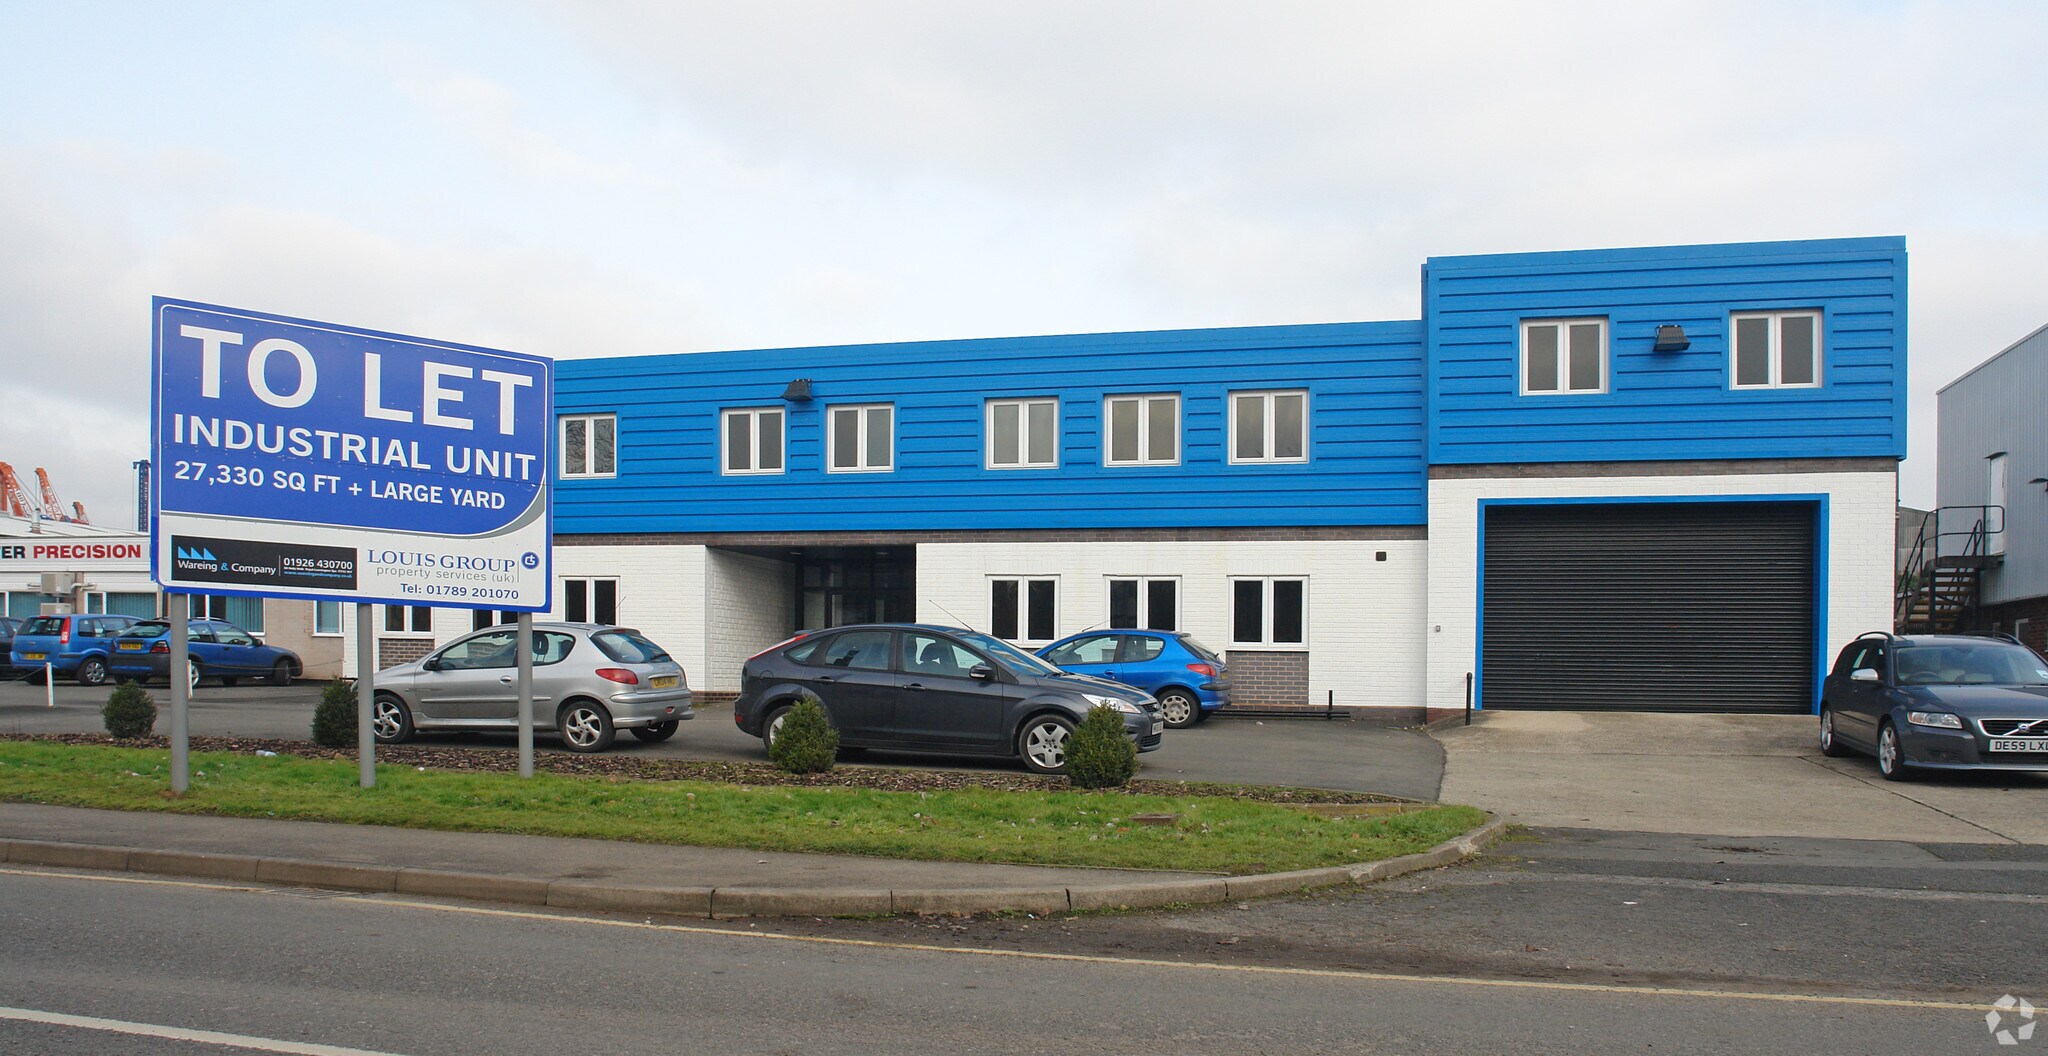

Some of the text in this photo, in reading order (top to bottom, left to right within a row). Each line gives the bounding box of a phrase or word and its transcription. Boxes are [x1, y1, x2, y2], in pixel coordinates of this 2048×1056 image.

[180, 324, 533, 436] TO LET
[174, 413, 536, 481] INDUSTRIAL UNIT
[174, 460, 506, 510] 27,330 SQ FT + LARGE YARD
[0, 544, 142, 559] ER PRECISION
[177, 560, 218, 572] Wareing
[220, 562, 229, 571] &
[231, 563, 276, 575] Company
[283, 557, 315, 568] 01926
[316, 560, 353, 570] 430700
[367, 549, 516, 573] LOUIS GROUP
[376, 566, 515, 583] property services (uk)
[400, 583, 519, 600] Tel: 01789 201070
[1995, 741, 2026, 751] DE59
